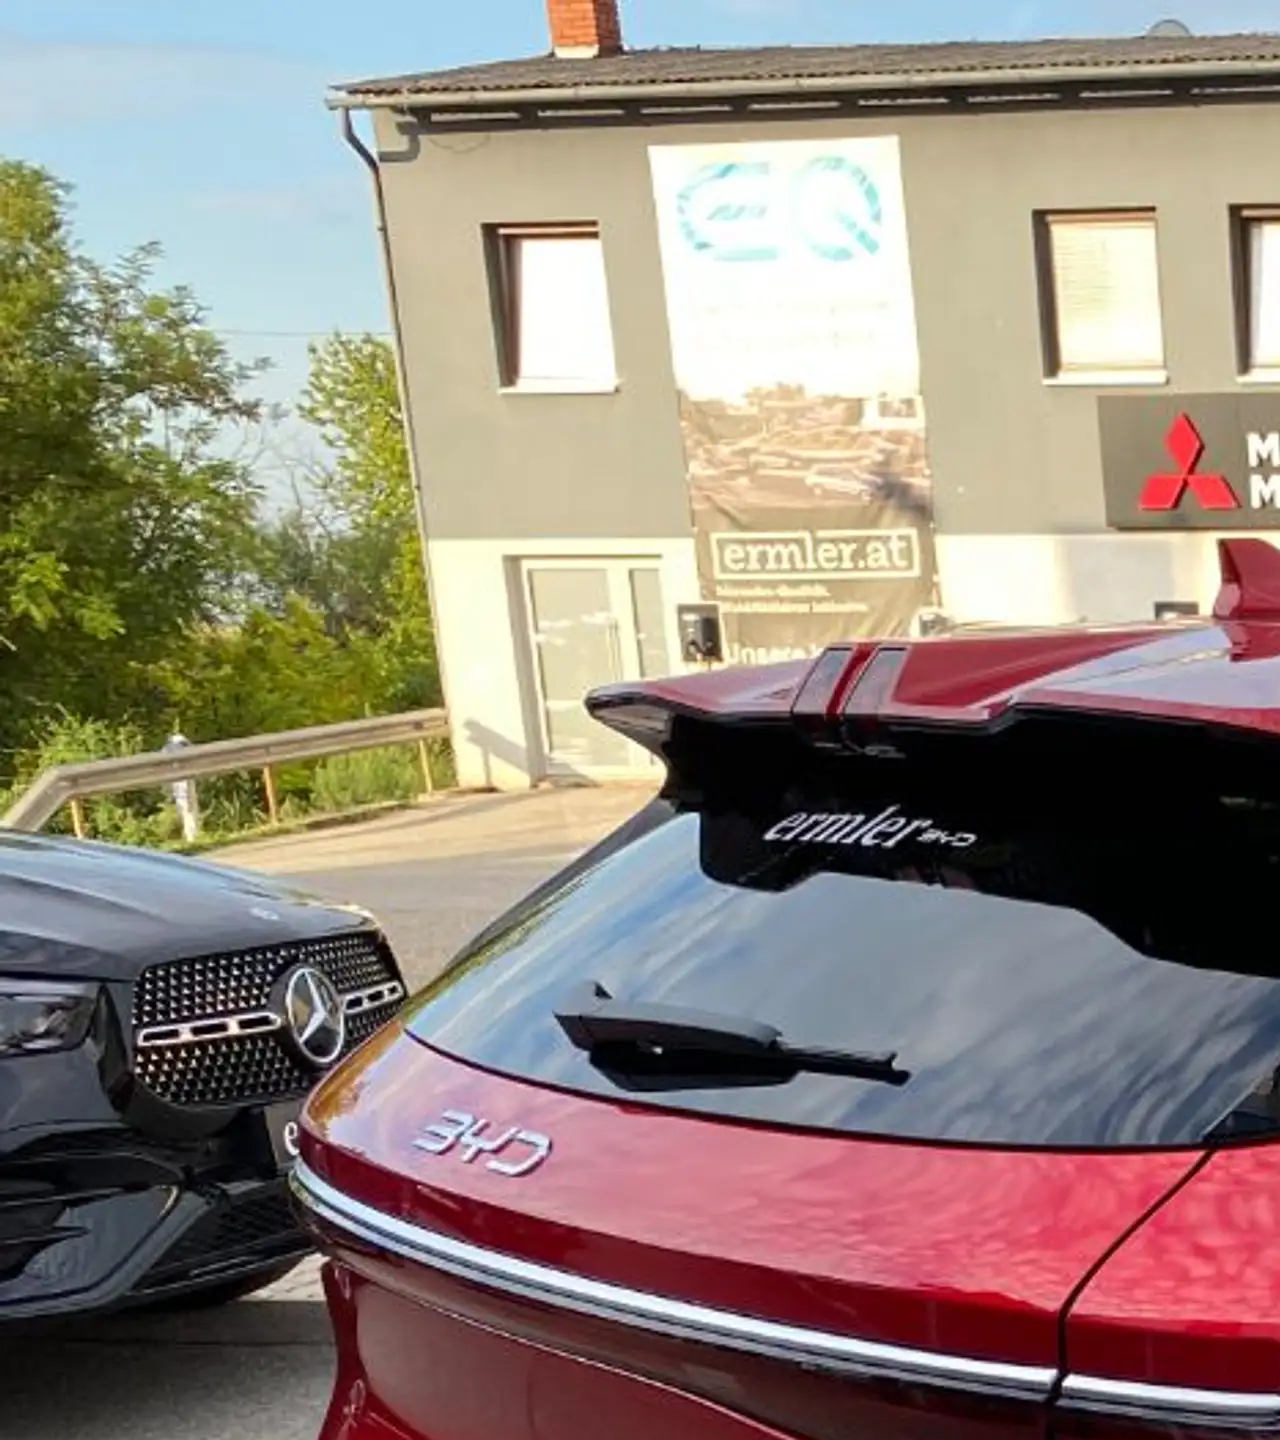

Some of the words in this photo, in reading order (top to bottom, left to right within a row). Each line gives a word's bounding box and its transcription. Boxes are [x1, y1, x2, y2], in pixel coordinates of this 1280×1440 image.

[722, 532, 910, 571] ermler.at
[762, 804, 932, 848] ermler
[411, 1108, 553, 1177] BYD
